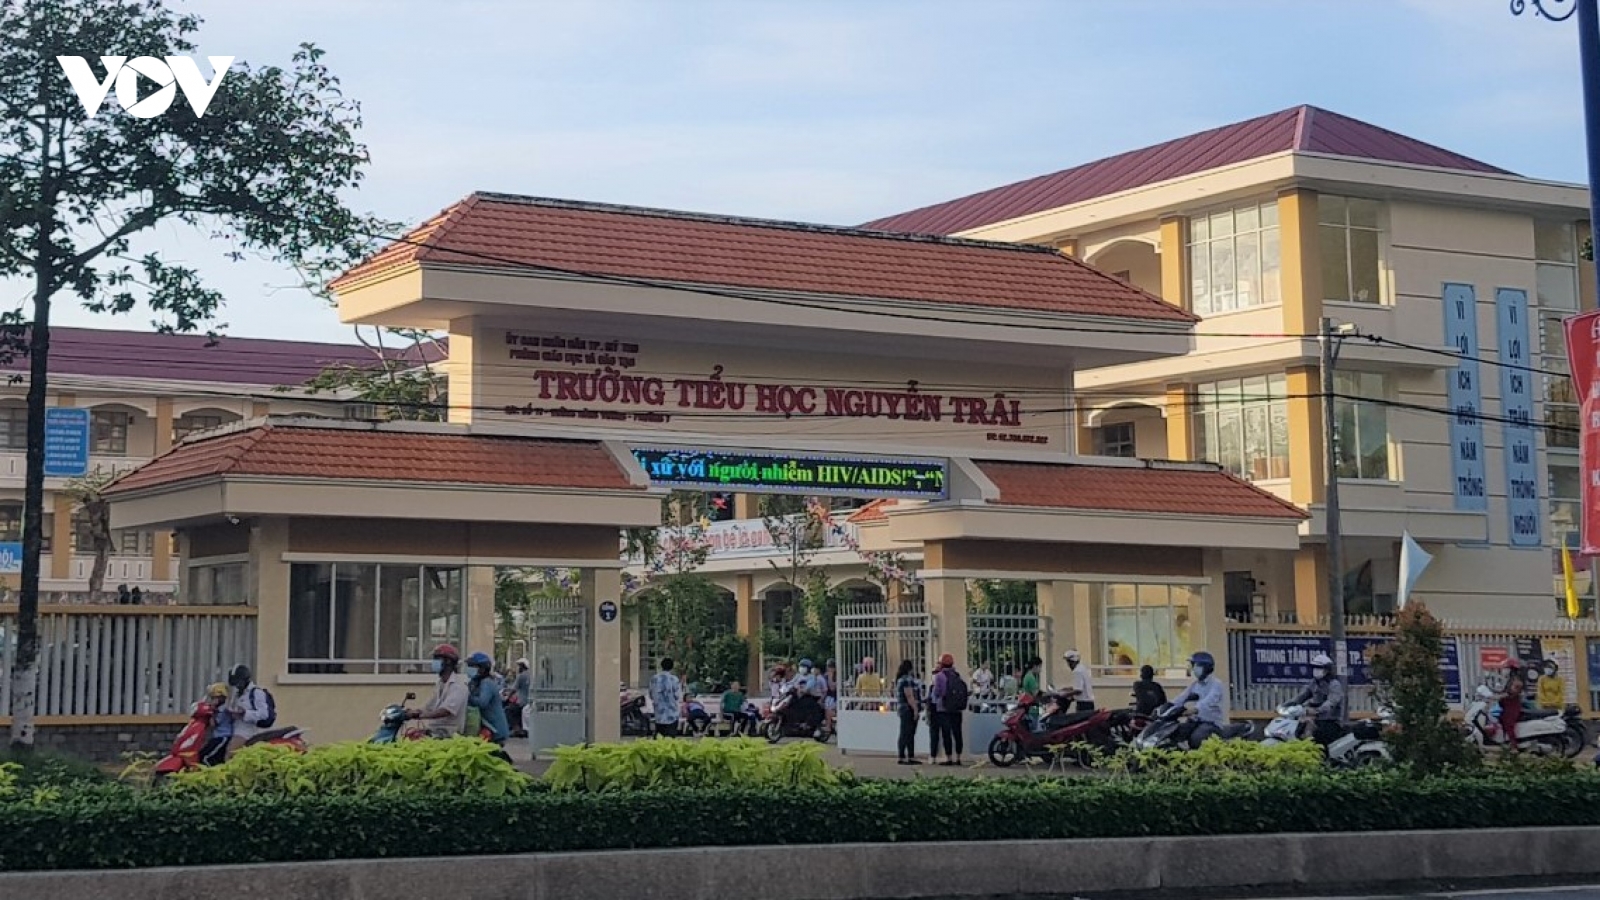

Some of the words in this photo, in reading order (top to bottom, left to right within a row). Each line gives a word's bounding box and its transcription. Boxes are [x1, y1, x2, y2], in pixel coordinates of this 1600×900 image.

[533, 366, 665, 405] TRƯỜNG
[672, 364, 748, 410] TIỂU
[754, 383, 816, 419] HỌC
[762, 460, 813, 482] nhiễm
[1255, 649, 1286, 664] TRUNG
